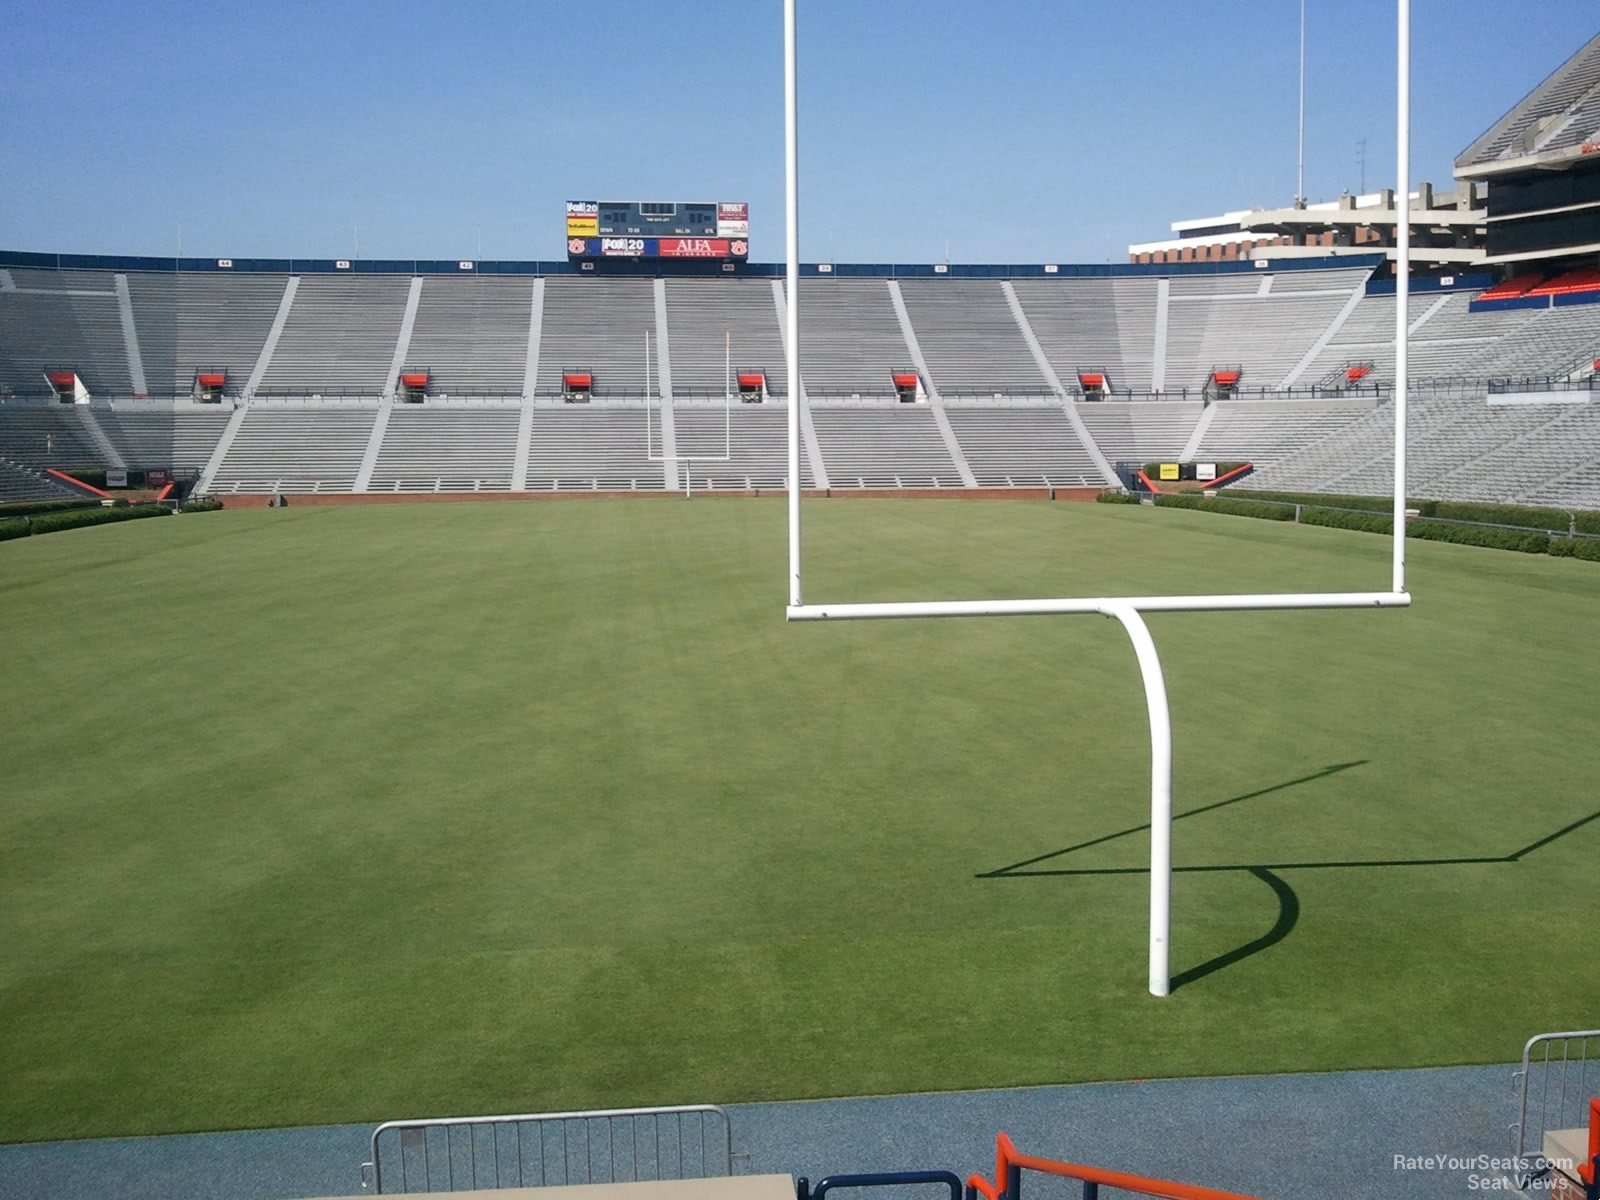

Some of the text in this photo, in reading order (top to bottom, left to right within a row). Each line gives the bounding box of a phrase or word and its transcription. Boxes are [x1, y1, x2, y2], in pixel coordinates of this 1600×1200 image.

[586, 204, 597, 213] 20
[602, 238, 644, 251] FOX 20
[677, 239, 711, 251] ALFA
